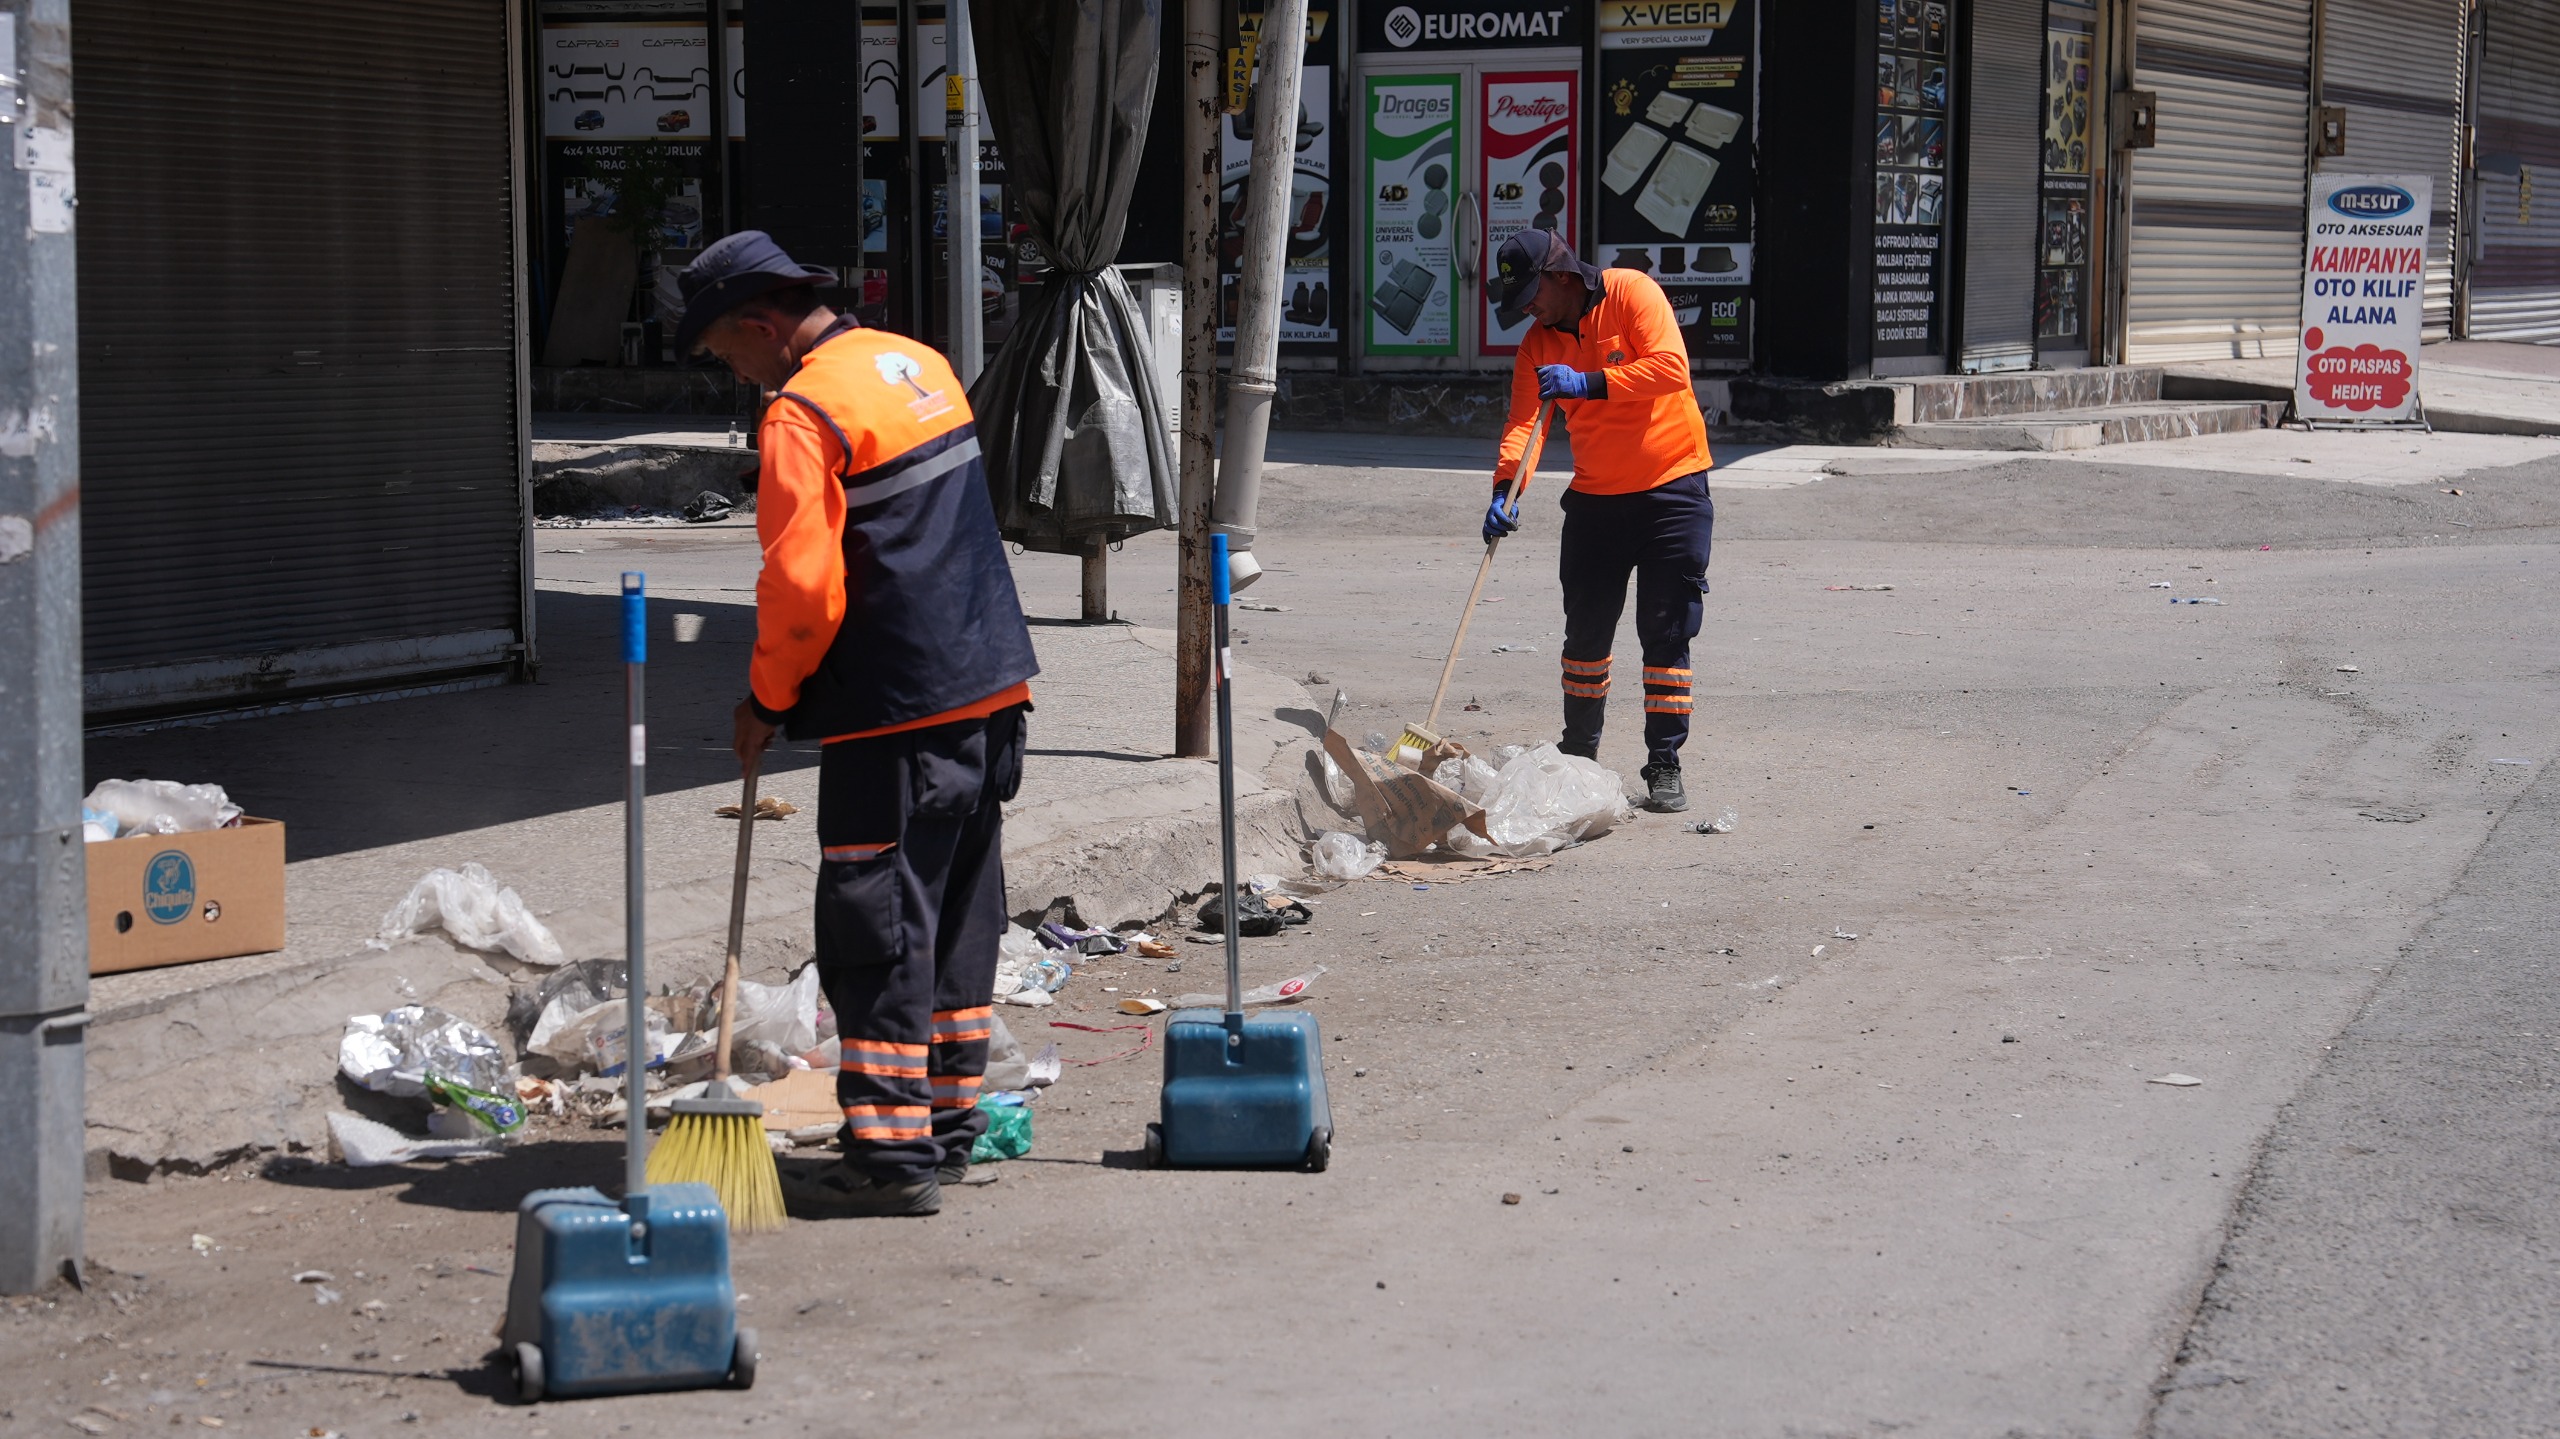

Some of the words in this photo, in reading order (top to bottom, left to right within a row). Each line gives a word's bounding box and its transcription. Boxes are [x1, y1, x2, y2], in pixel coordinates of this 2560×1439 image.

[1621, 3, 1719, 26] X-VEGA
[1425, 11, 1563, 39] EUROMAT
[1383, 95, 1450, 119] Dragos
[1489, 95, 1567, 123] Prestige
[1226, 160, 1248, 171] ARACA
[1375, 226, 1414, 234] UNIVERSAL
[2317, 223, 2346, 235] OTO
[2347, 224, 2424, 236] AKSESUAR
[1489, 234, 1504, 242] CAR
[1882, 235, 1910, 248] OFFROAD
[1910, 233, 1939, 249] ÜRÜNLERİ
[1876, 254, 1903, 267] ROLLBAR
[1904, 251, 1932, 270] ÇEŞİTLERİ
[2311, 246, 2421, 273] KAMPANYA
[1877, 273, 1890, 285] YAN
[1890, 272, 1930, 285] BASAMAKLAR
[2314, 278, 2355, 297] OTO
[2363, 279, 2417, 298] KILIF
[1669, 293, 1698, 306] ESİM
[1882, 291, 1898, 304] ARKA
[1898, 290, 1935, 303] KORUMALAR
[1711, 301, 1736, 318] ECO
[1876, 309, 1896, 322] BAGAJ
[1897, 306, 1929, 322] SİSTEMLERİ
[2327, 306, 2397, 324] ALANA
[1294, 330, 1331, 340] KILIFLARI
[1713, 333, 1734, 341] %100
[1877, 328, 1886, 341] VE
[1886, 324, 1905, 340] DODİK
[1905, 323, 1928, 339] SETLERİ
[2318, 358, 2347, 374] OTO
[2349, 358, 2402, 374] PASPAS
[2332, 381, 2382, 400] HEDİYE
